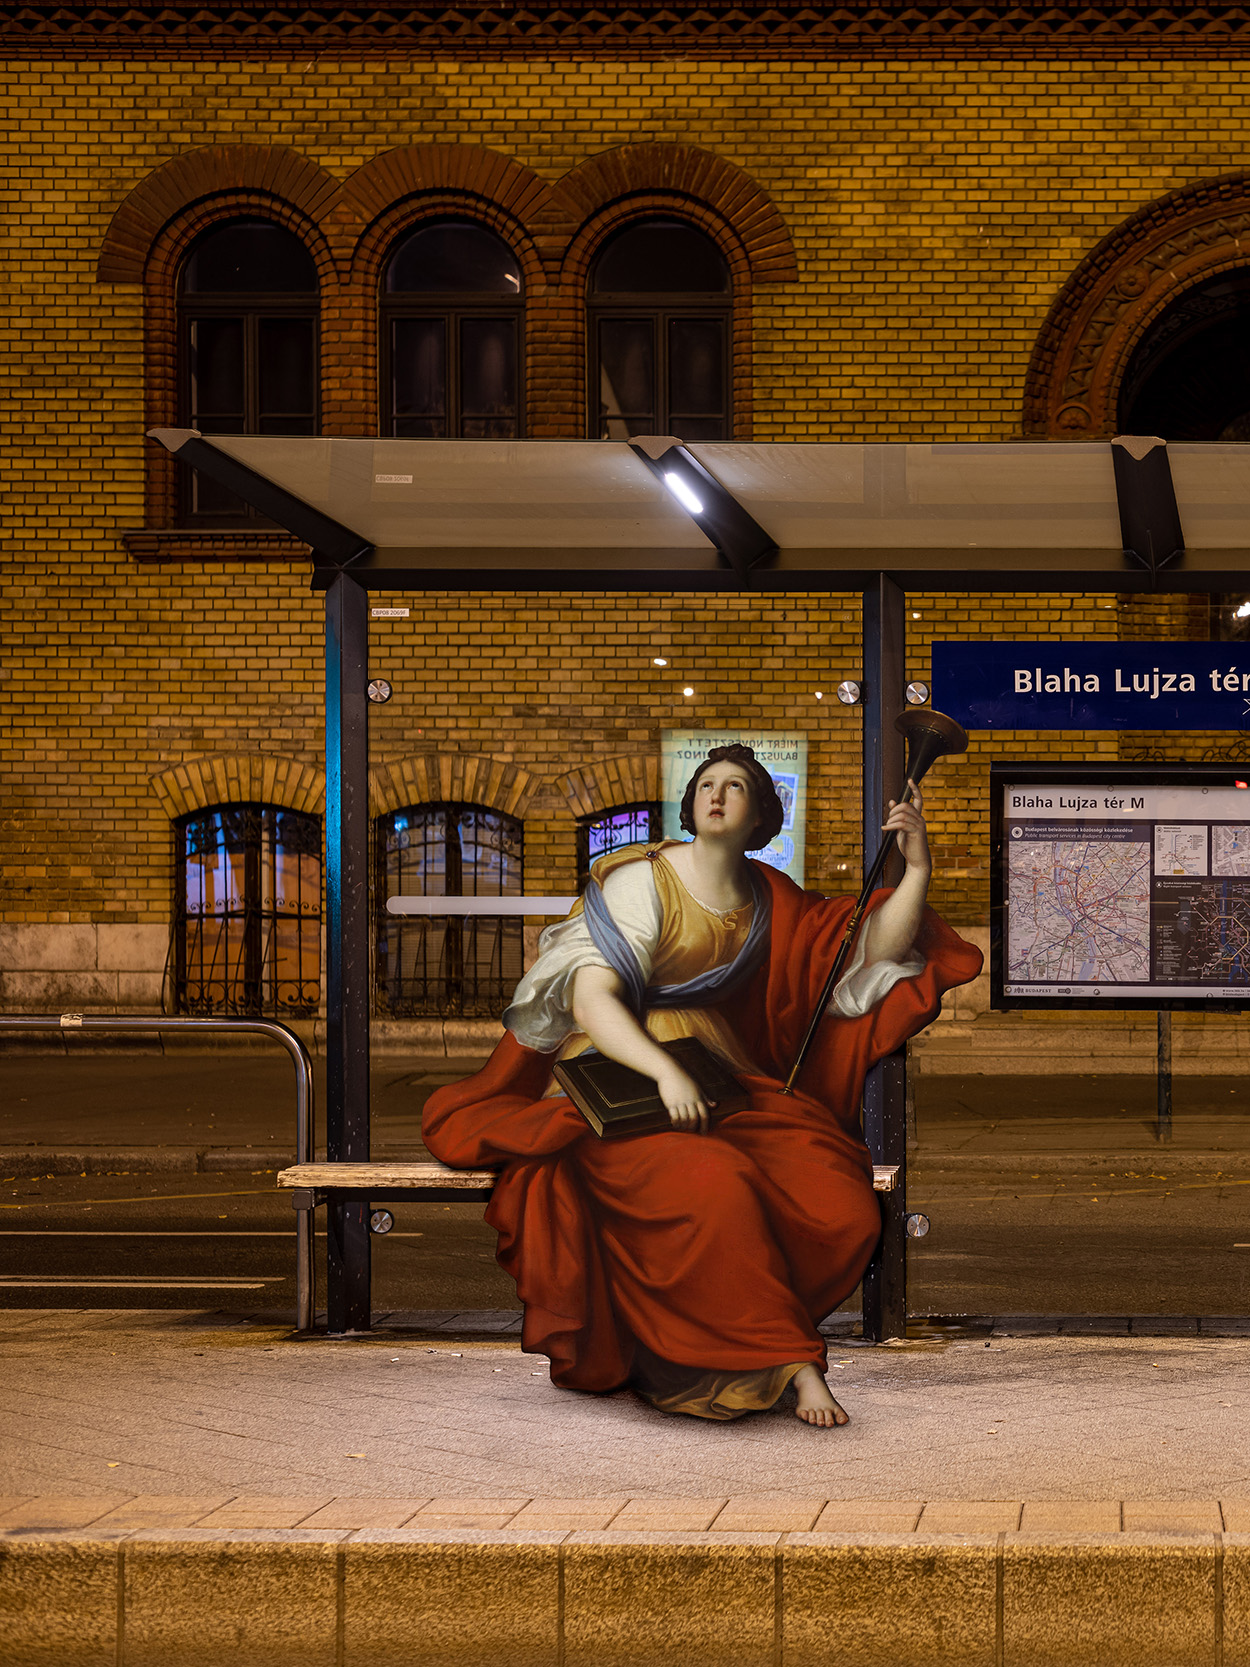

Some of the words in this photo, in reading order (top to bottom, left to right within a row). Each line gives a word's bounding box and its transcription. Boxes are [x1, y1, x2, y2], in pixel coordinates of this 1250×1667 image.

[1014, 667, 1100, 693] Blaha
[1115, 667, 1196, 699] Lujza
[1012, 795, 1053, 808] Blaha
[1059, 796, 1098, 812] Lujza
[1103, 796, 1125, 809] tér
[1130, 797, 1144, 809] M
